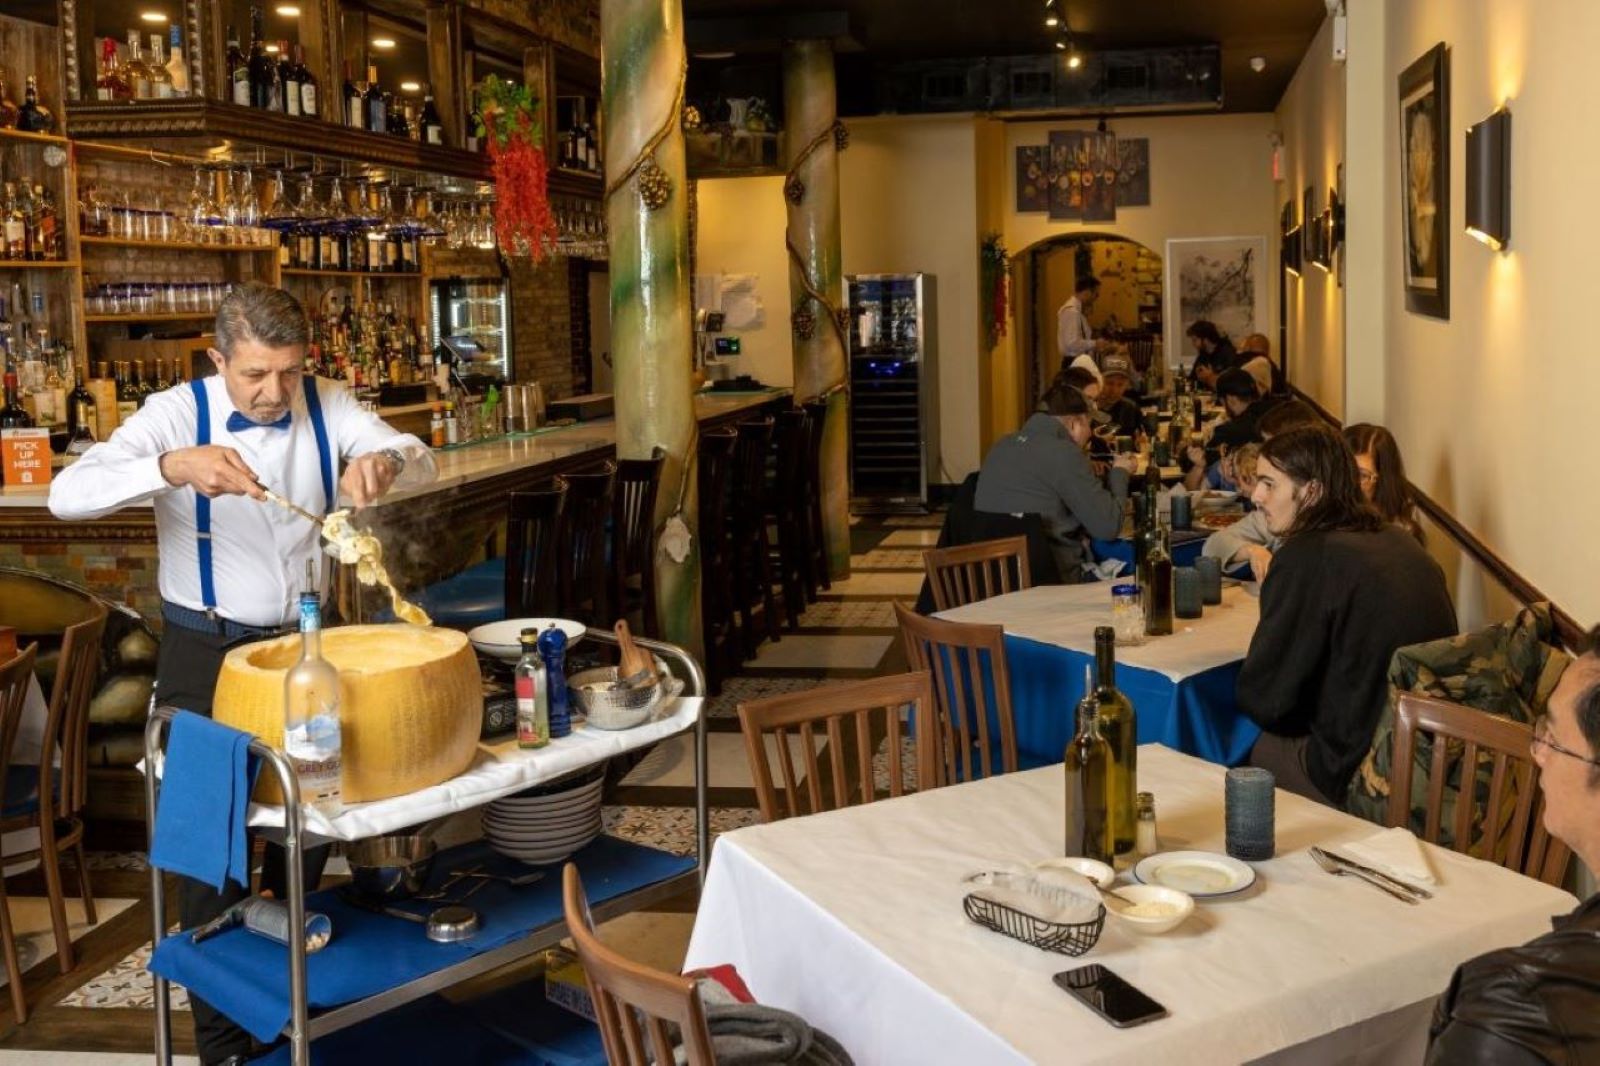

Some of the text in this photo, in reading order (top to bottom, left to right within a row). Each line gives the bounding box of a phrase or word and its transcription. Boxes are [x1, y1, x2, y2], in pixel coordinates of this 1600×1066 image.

[13, 442, 39, 450] PICK
[20, 450, 34, 459] UP
[13, 460, 41, 468] HERE
[296, 763, 324, 774] GREY
